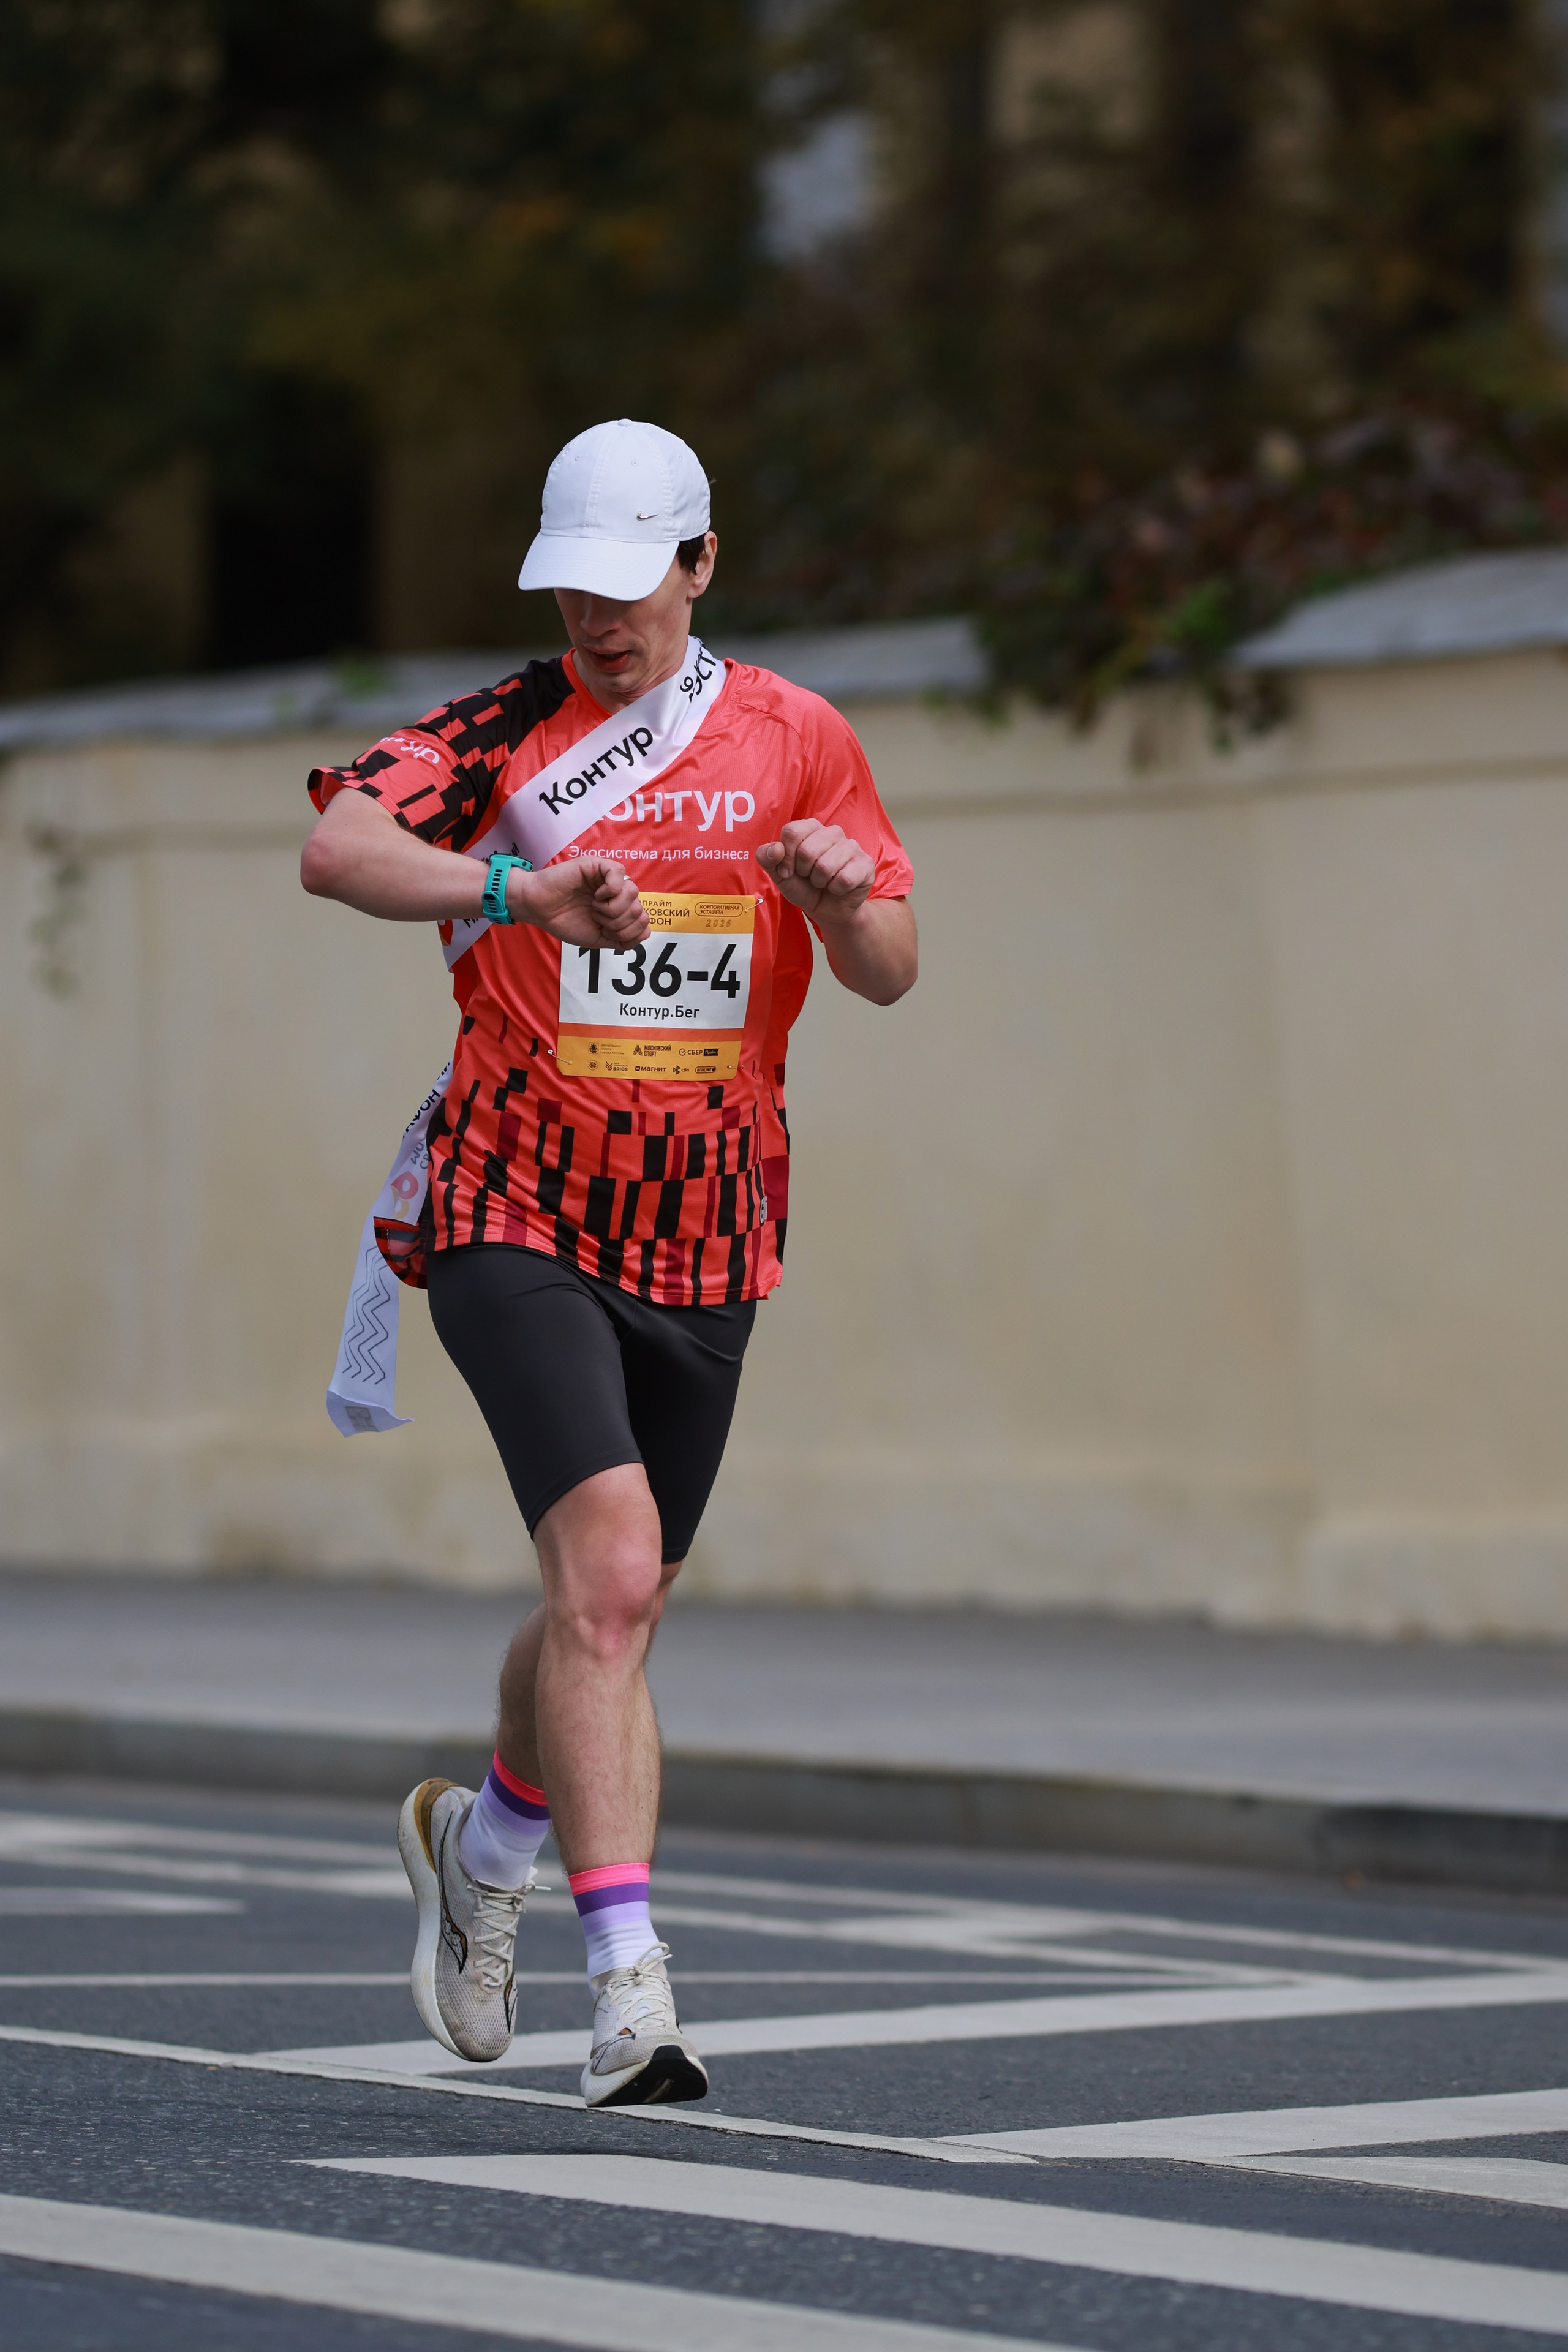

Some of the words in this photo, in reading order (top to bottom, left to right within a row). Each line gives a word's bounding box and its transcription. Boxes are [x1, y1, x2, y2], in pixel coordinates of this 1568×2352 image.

[539, 727, 654, 816] Контур
[598, 790, 755, 832] онтур
[568, 846, 658, 860] Экосистема
[662, 849, 690, 861] для
[694, 846, 750, 861] бизнеса
[644, 908, 690, 918] КОВСКИЙ
[578, 942, 741, 998] 136-4
[620, 1003, 700, 1020] Контур.Бег
